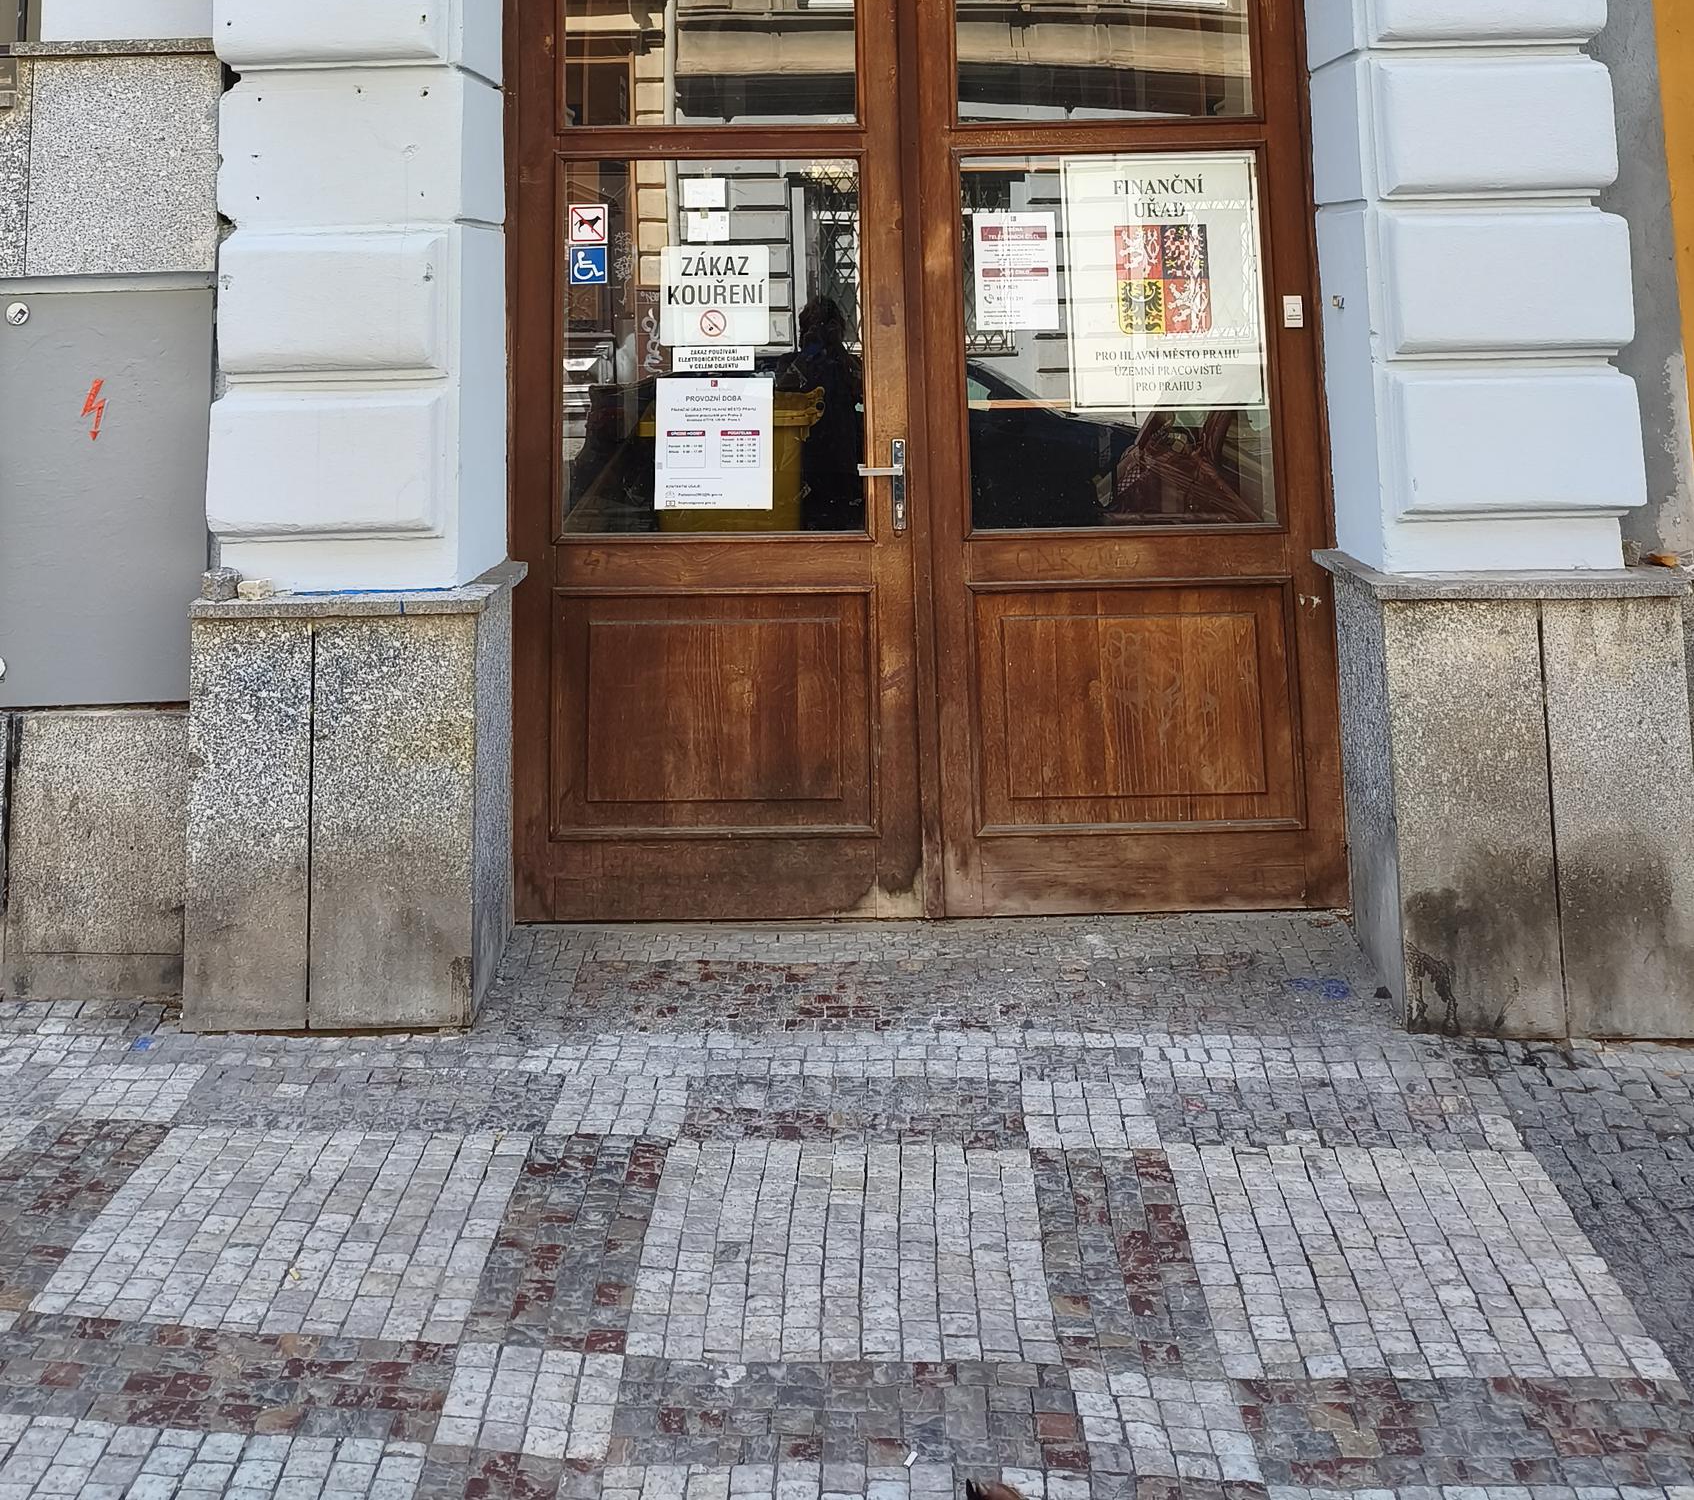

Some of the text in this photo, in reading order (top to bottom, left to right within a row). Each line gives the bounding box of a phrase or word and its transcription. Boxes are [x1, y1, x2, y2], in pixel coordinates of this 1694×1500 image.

[1113, 173, 1204, 195] FINANČNÍ
[1134, 197, 1186, 218] ÚŘAD
[681, 251, 750, 276] ZÁKAZ
[667, 278, 765, 305] KOUŘENÍ
[1095, 348, 1240, 361] PRO HLAVNÍ MĚSTO PRAHU
[1114, 363, 1223, 377] ÚZEMNÍ PRACOVIŠTĚ
[1135, 381, 1203, 392] PRO PRAHU 3
[685, 394, 742, 403] PROVOZNÍ DOBA
